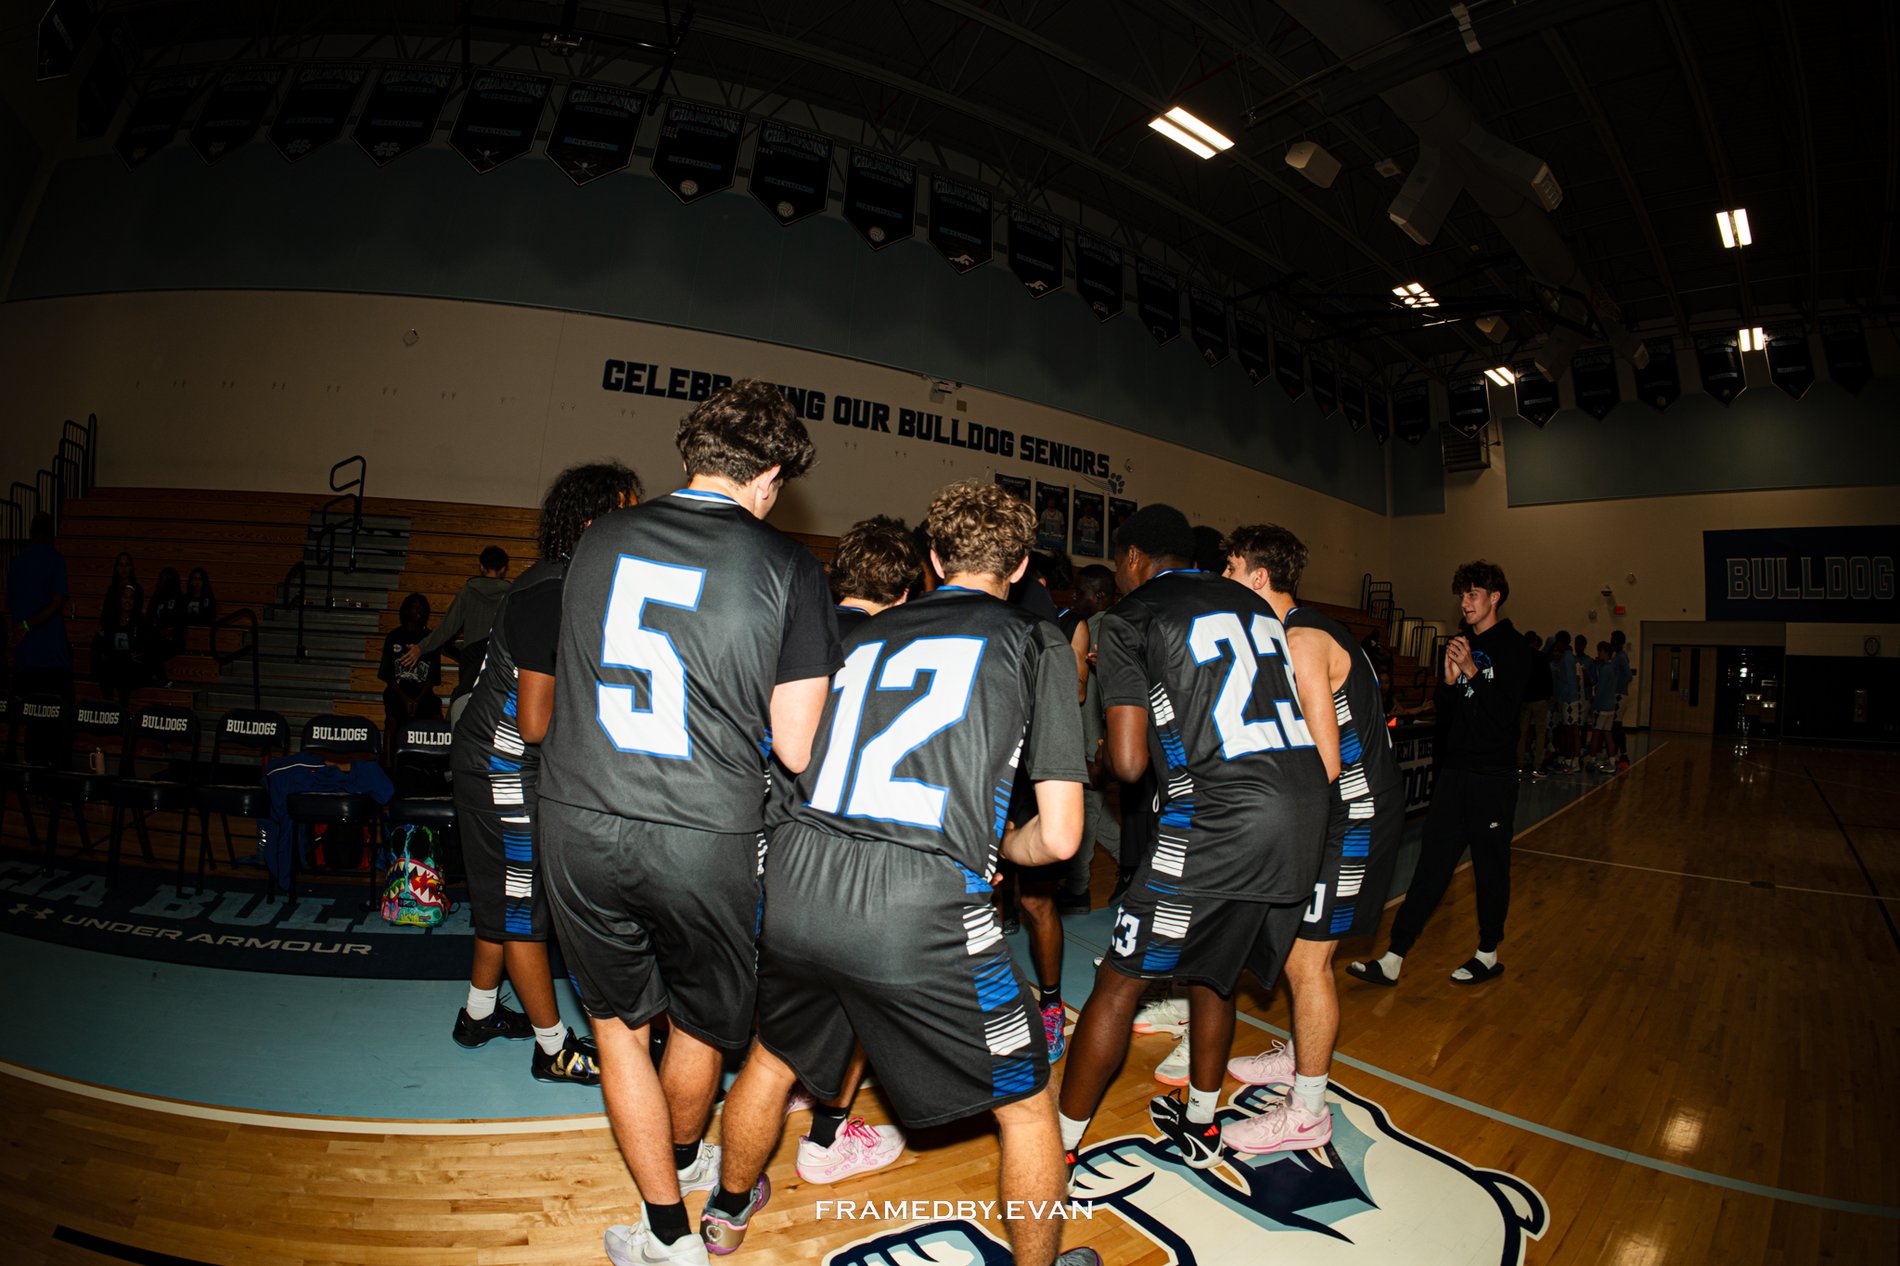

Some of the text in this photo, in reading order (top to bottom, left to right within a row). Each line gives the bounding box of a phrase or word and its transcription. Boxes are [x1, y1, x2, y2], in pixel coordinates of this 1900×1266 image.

[833, 395, 891, 434] OUR
[897, 407, 1015, 458] BULLDOG
[1020, 434, 1110, 479] SENIORS
[1725, 555, 1896, 601] BULLDOG
[596, 553, 708, 761] 5
[1186, 610, 1317, 762] 23
[22, 702, 61, 718] BULLDOGS
[77, 708, 120, 725] BULLDOGS
[141, 714, 188, 732] BULLDOGS
[226, 719, 278, 736] BULLDOGS
[312, 726, 368, 742] BULLDOGS
[803, 634, 989, 833] 12
[62, 913, 373, 956] UNDER ARMOUR
